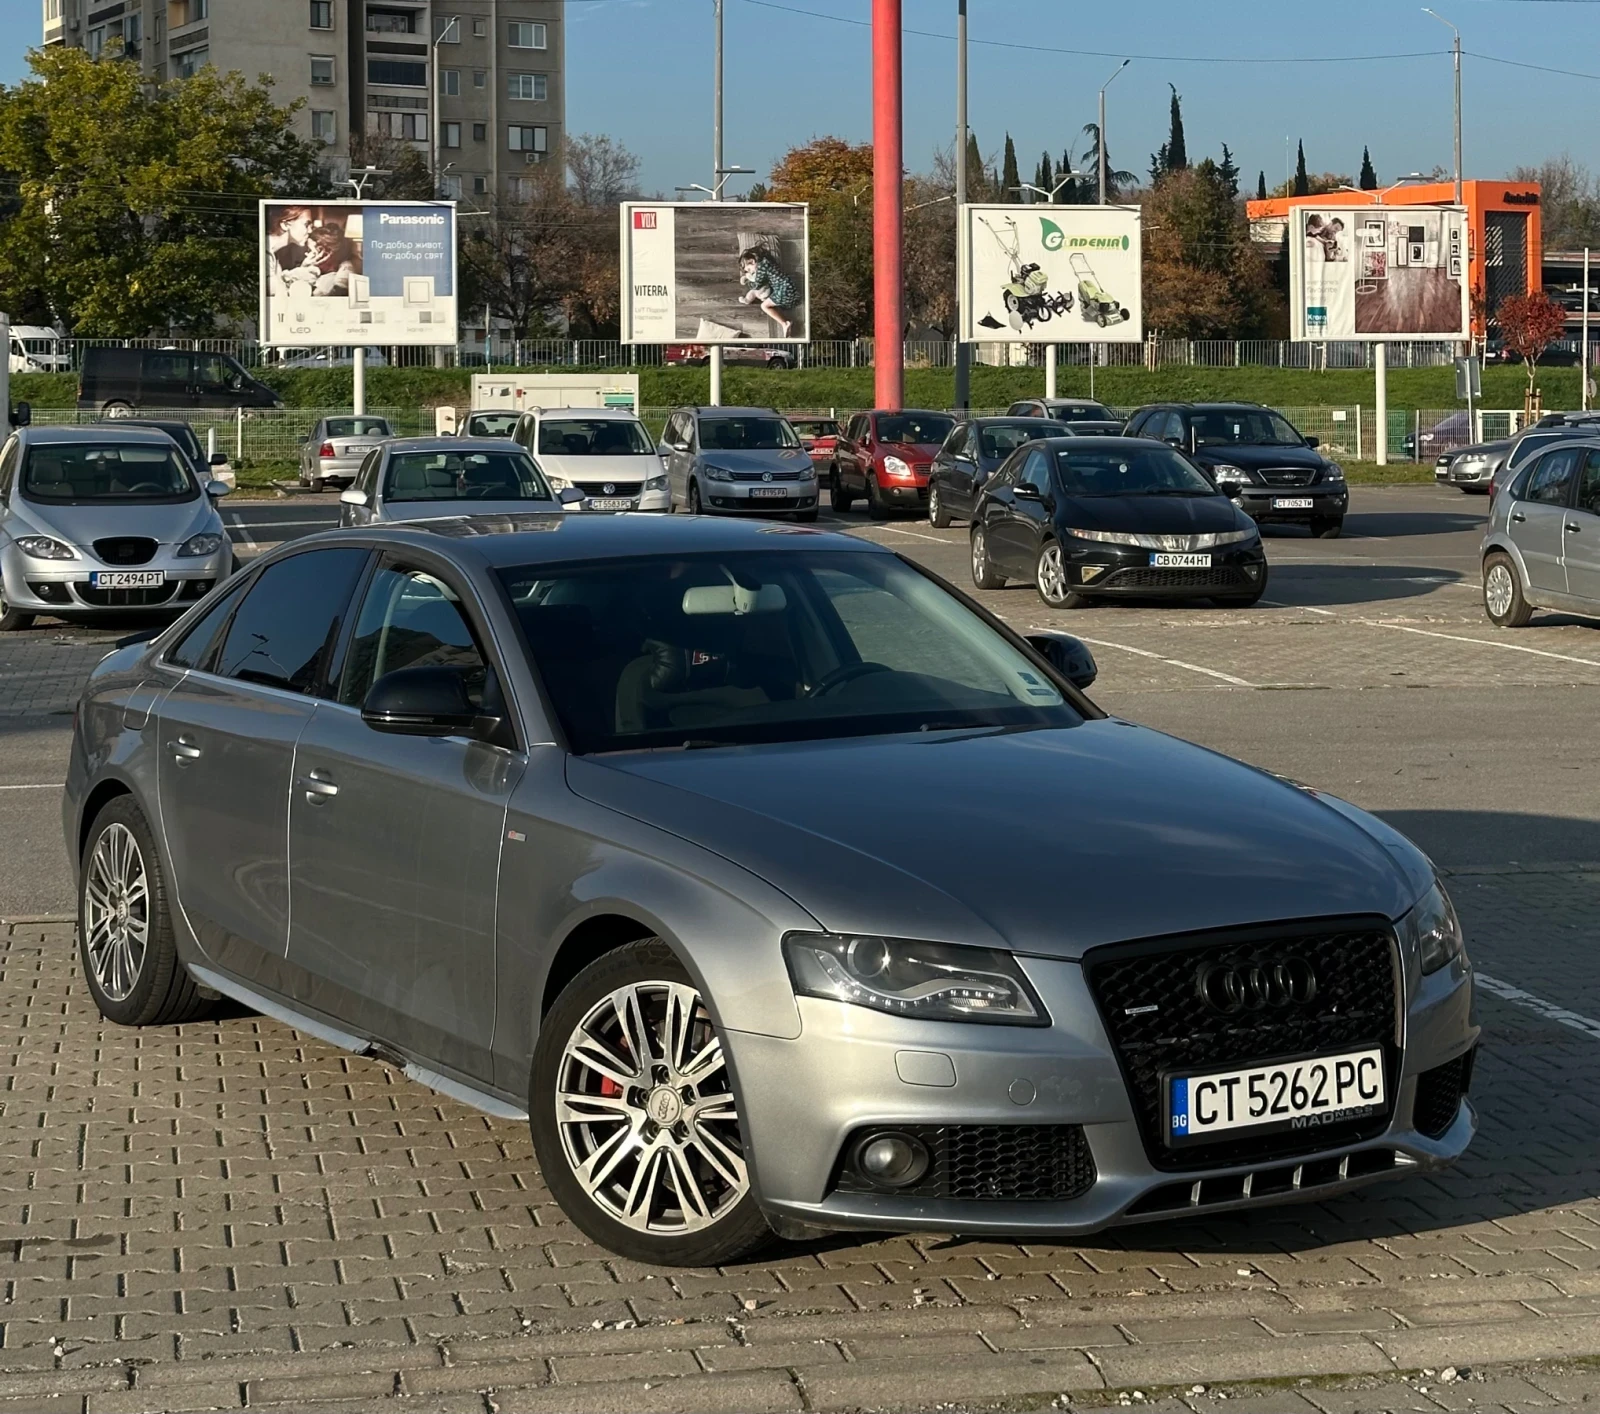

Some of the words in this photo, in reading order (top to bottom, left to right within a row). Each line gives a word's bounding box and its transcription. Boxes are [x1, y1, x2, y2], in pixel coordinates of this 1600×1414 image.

[380, 213, 445, 225] Panasonic
[641, 212, 656, 228] VOX
[371, 240, 413, 250] По-добър
[414, 241, 444, 250] живот,
[381, 251, 422, 261] по-добър
[424, 252, 444, 260] свят
[634, 285, 668, 296] VITERRA
[1157, 555, 1170, 566] CB
[1171, 555, 1195, 566] 0744
[1196, 555, 1210, 566] HT
[99, 574, 115, 585] CT
[116, 574, 144, 585] 2494
[146, 573, 161, 584] PT
[1195, 1077, 1240, 1125] CT
[1248, 1064, 1329, 1117] 5262
[1335, 1057, 1378, 1104] PC
[1172, 1114, 1187, 1128] BG
